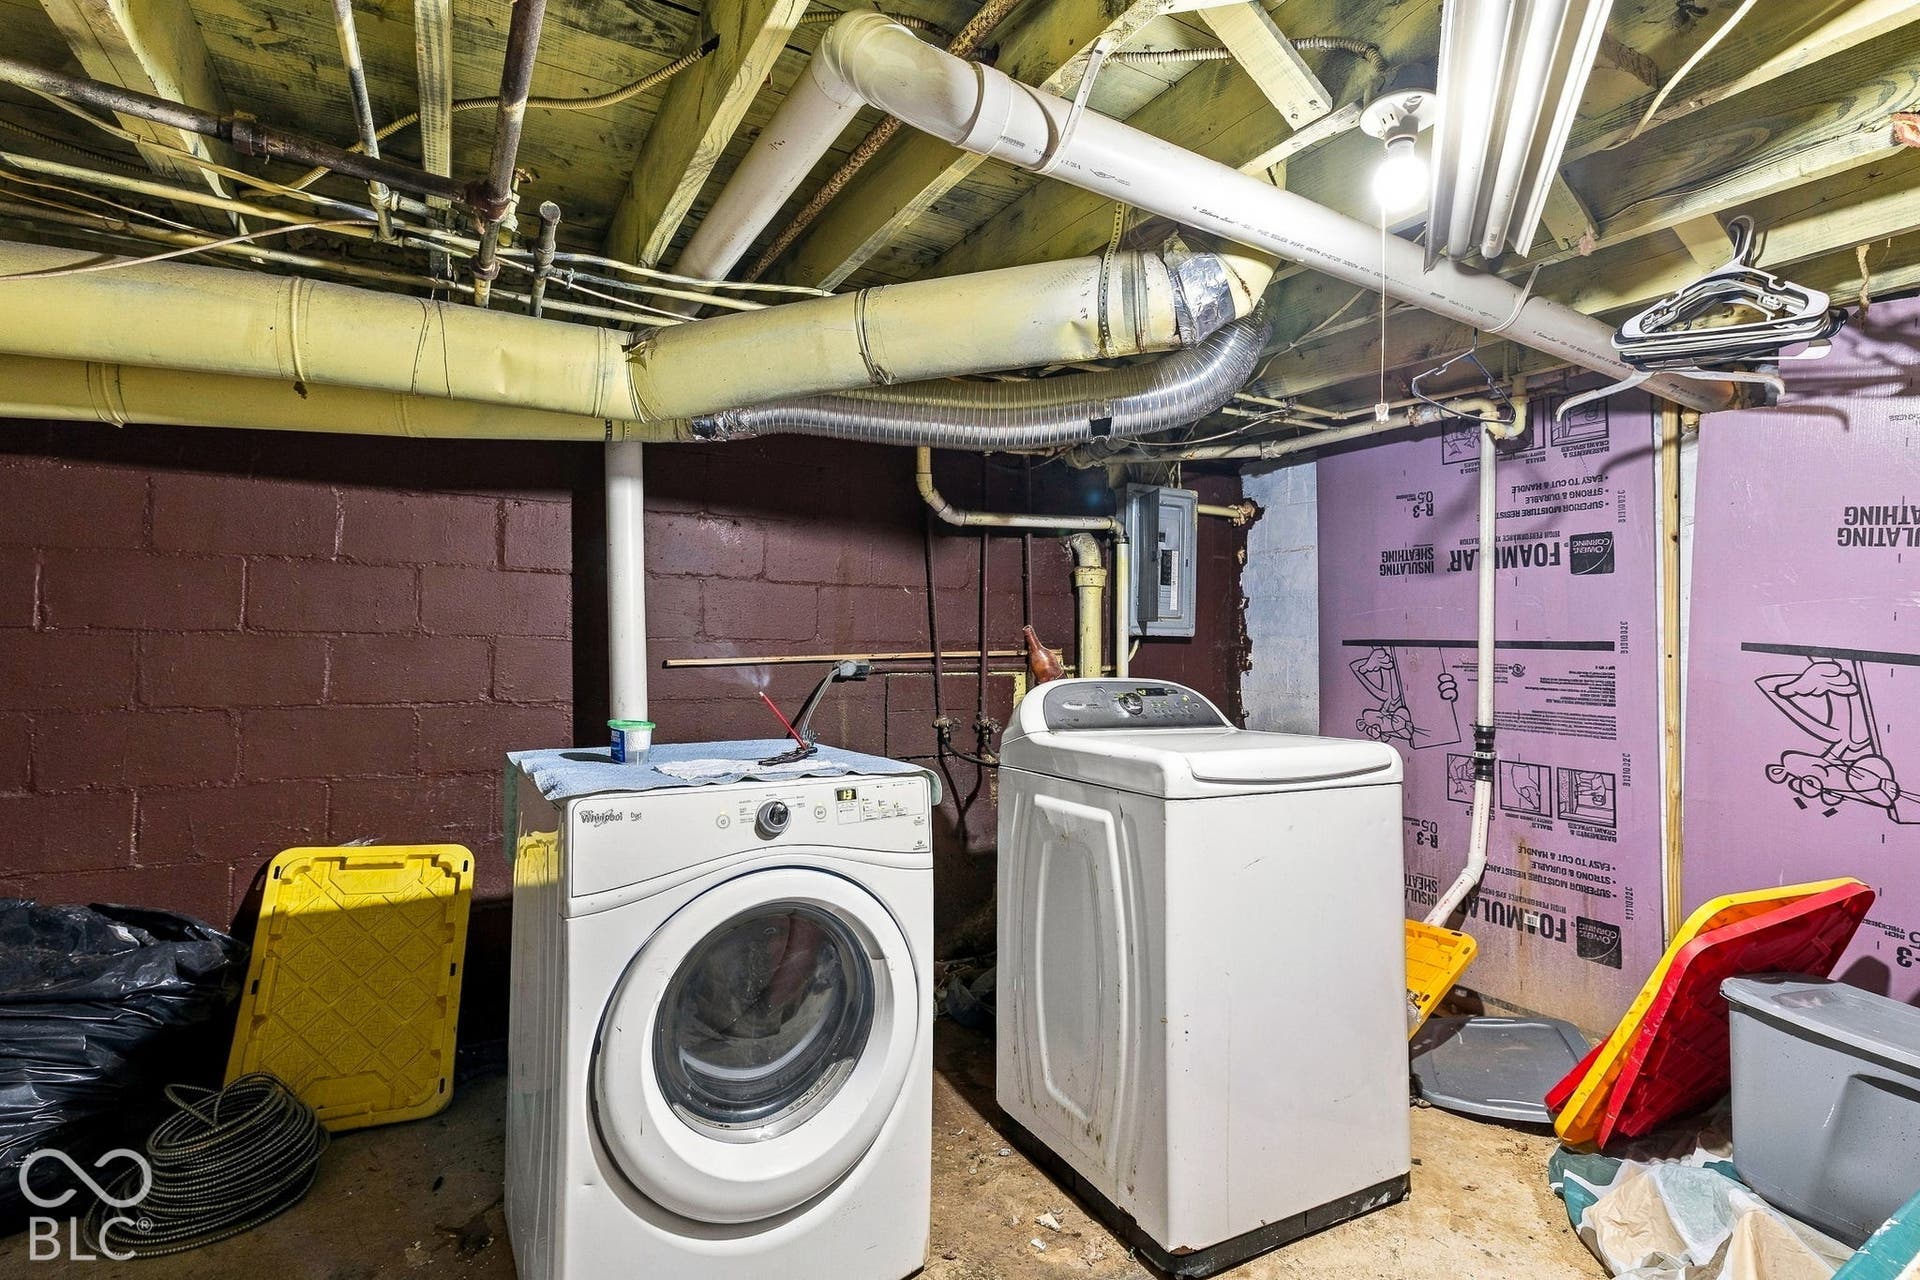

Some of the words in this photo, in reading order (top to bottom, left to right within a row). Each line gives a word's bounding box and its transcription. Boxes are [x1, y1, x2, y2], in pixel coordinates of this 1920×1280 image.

[1551, 480, 1566, 488] CUT
[1568, 478, 1580, 487] TO
[1581, 474, 1602, 485] EASY
[1511, 482, 1542, 494] HANDLE
[1569, 487, 1603, 499] STRONG
[1417, 491, 1434, 504] 0.5
[1525, 494, 1560, 504] DURABLE
[1413, 503, 1434, 518] R-3
[1521, 505, 1561, 517] MOISTURE
[1562, 501, 1604, 512] SUPERIOR
[1844, 506, 1920, 525] ATHING
[1572, 538, 1610, 547] CORNING
[1381, 547, 1434, 563] SHEATHING
[1572, 545, 1604, 554] OWENS
[1449, 542, 1560, 572] FOAMAR
[1379, 560, 1434, 576] INSULATING
[579, 809, 622, 828] Whirlpool
[1421, 820, 1438, 834] 0.5
[1416, 831, 1438, 848] R-3
[1518, 846, 1548, 859] HANDLE
[1558, 854, 1574, 864] CUT
[1531, 861, 1567, 875] DURABLE
[1575, 858, 1586, 867] TO
[1588, 860, 1610, 871] EASY
[1485, 864, 1526, 879] RESISTANC
[1568, 869, 1575, 877] &
[1576, 870, 1611, 884] STRONG
[1528, 872, 1568, 889] MOISTURE
[1569, 882, 1611, 898] SUPERIOR
